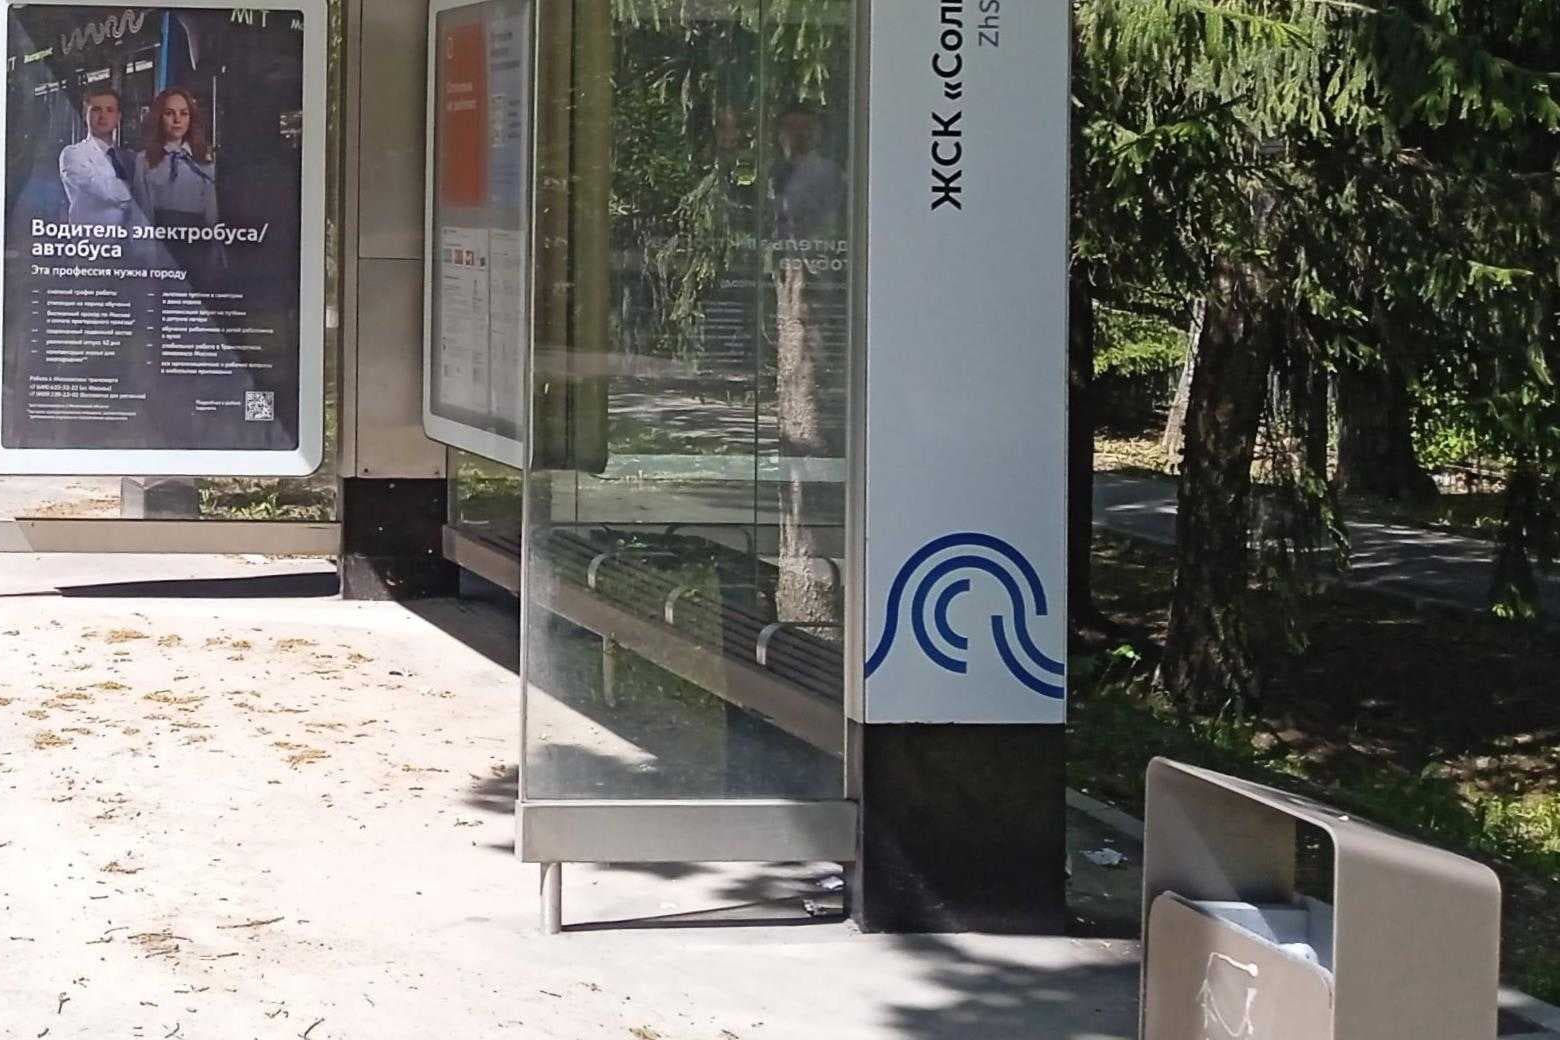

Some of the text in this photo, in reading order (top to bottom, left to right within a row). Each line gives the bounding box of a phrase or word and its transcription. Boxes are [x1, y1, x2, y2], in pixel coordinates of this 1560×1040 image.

[931, 111, 963, 211] ЖСК
[31, 219, 269, 245] Водитель электробуса/
[31, 240, 122, 261] автобуса
[31, 265, 187, 280] Эта профессия нужна городу
